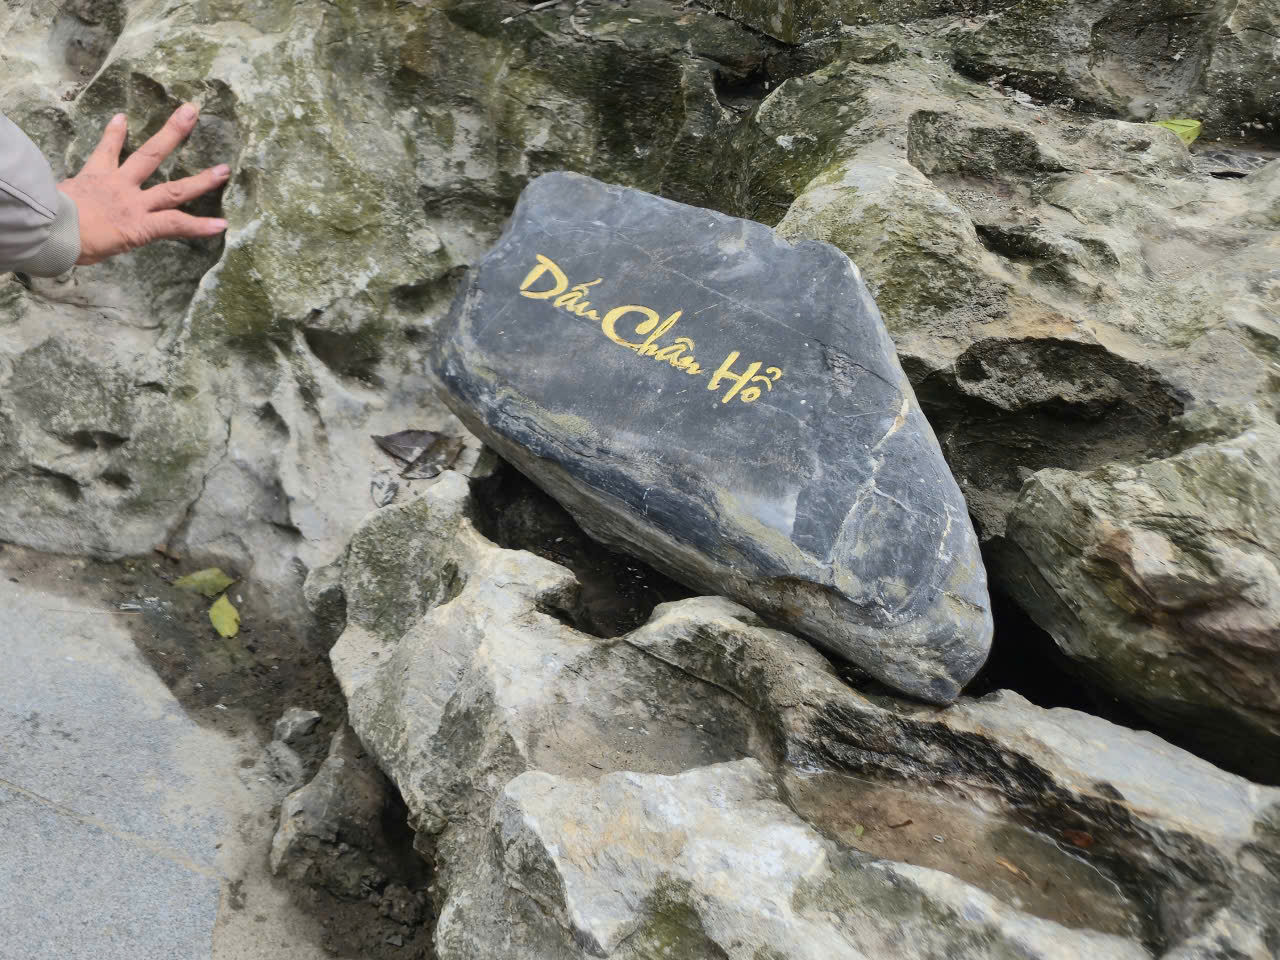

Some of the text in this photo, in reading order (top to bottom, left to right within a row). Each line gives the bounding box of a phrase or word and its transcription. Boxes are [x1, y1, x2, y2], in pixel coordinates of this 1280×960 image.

[519, 253, 783, 404] Dấu Chân Hổ
